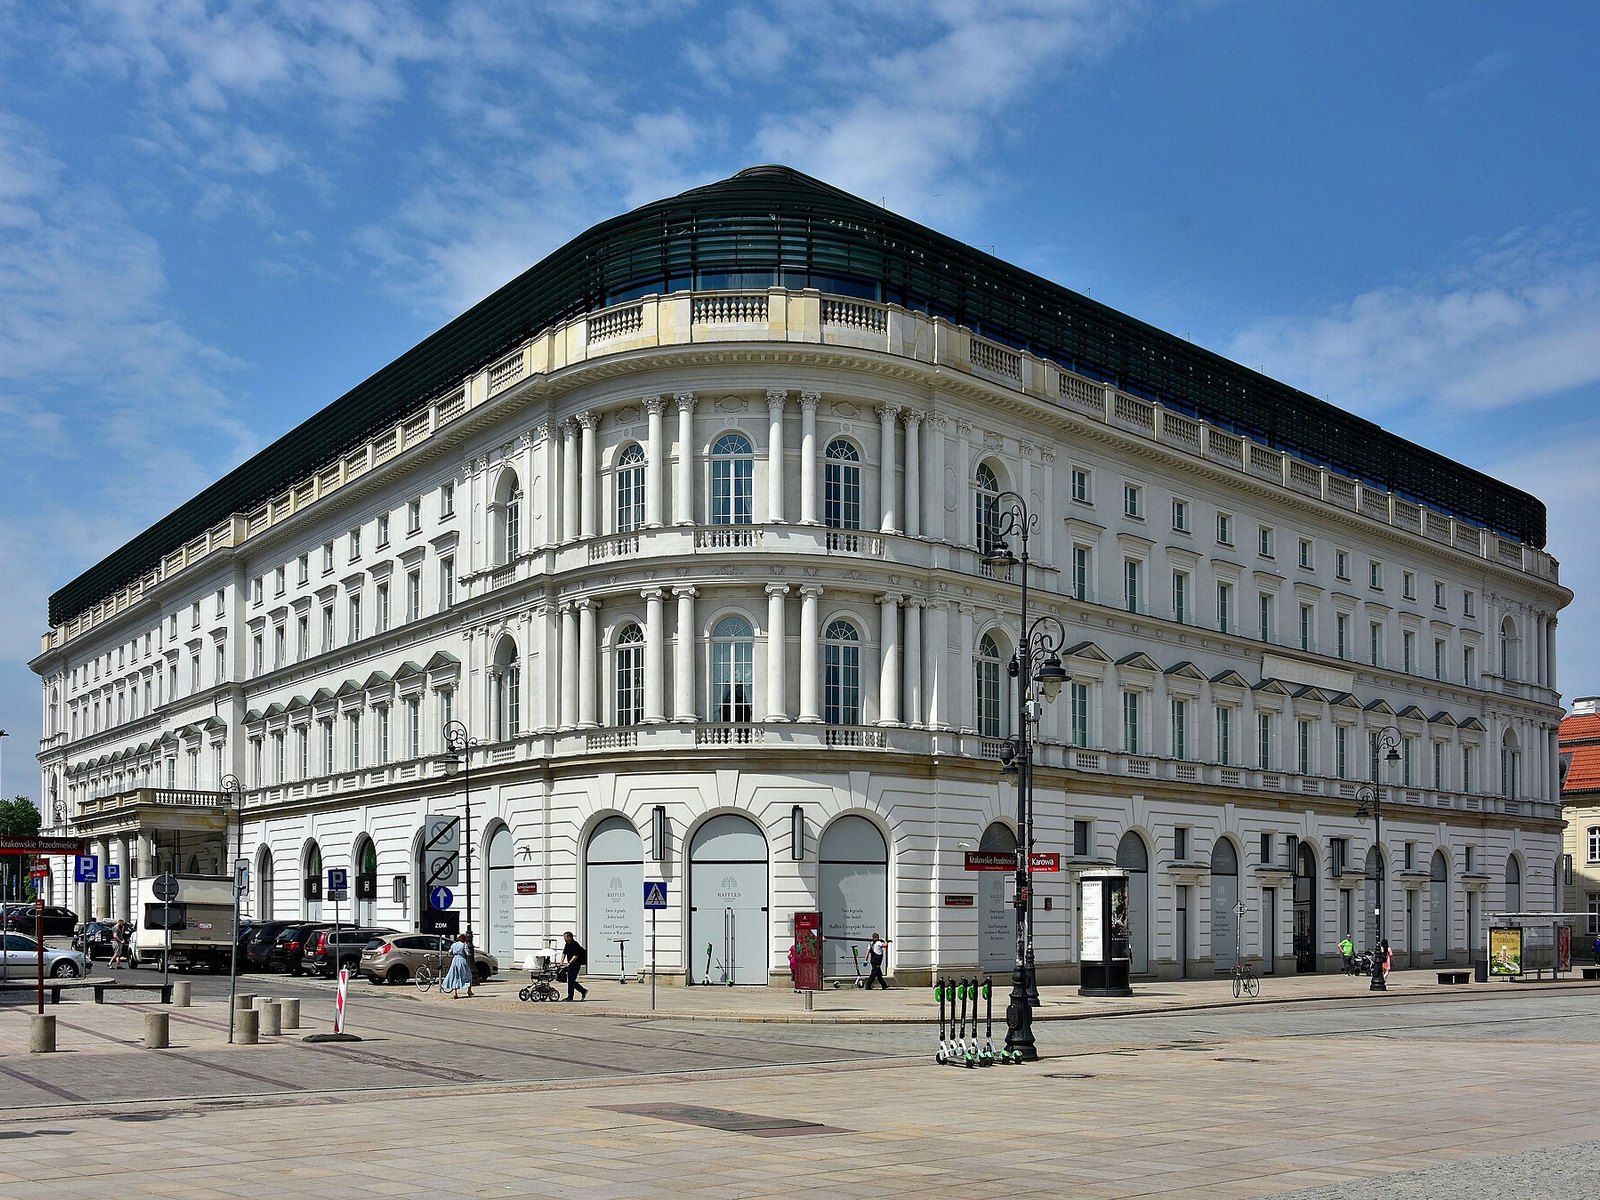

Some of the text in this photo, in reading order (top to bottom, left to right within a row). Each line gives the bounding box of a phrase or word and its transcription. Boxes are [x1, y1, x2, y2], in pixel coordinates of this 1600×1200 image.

[1, 840, 79, 850] Krakowskie Przedmieście
[969, 855, 993, 865] Krakowskie
[1031, 858, 1054, 866] Karowa
[80, 857, 94, 875] P
[107, 866, 117, 877] P
[333, 871, 344, 888] P
